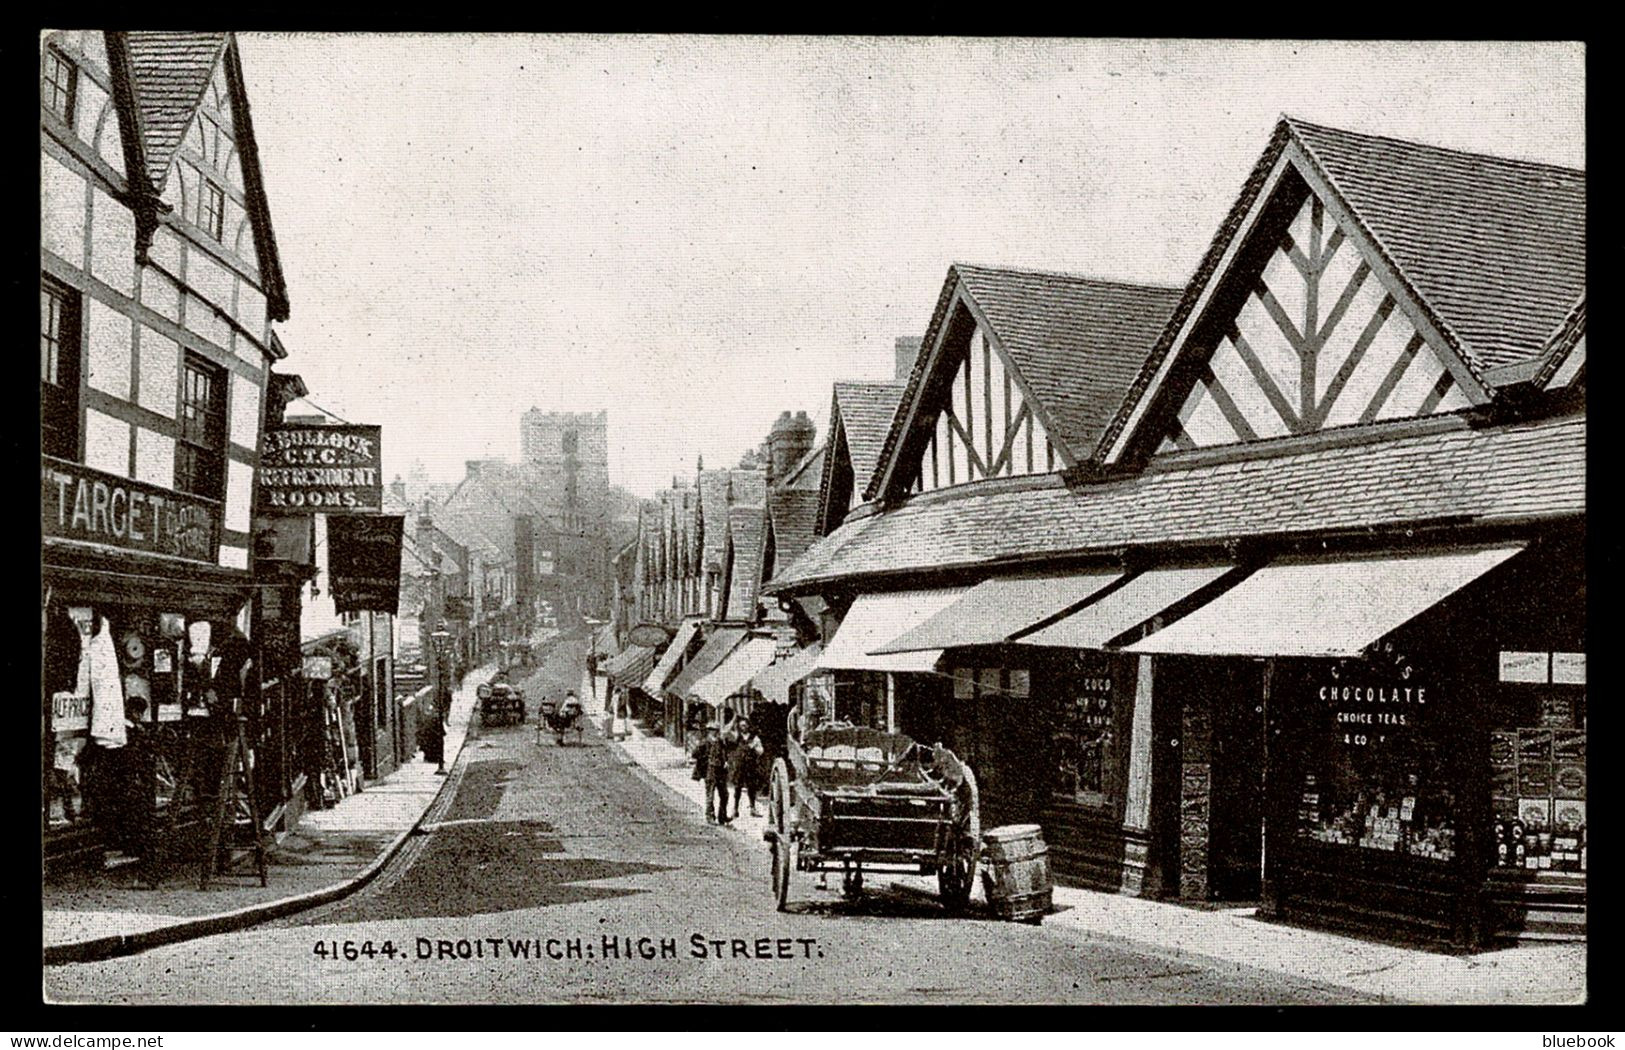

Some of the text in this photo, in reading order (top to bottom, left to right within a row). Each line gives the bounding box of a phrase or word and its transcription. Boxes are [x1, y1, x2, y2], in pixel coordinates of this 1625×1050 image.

[260, 467, 377, 486] REFRESHMENT
[270, 491, 363, 506] ROOMS.
[1319, 686, 1425, 703] CHOCOLATE
[1337, 712, 1406, 725] CHOICE TEAS
